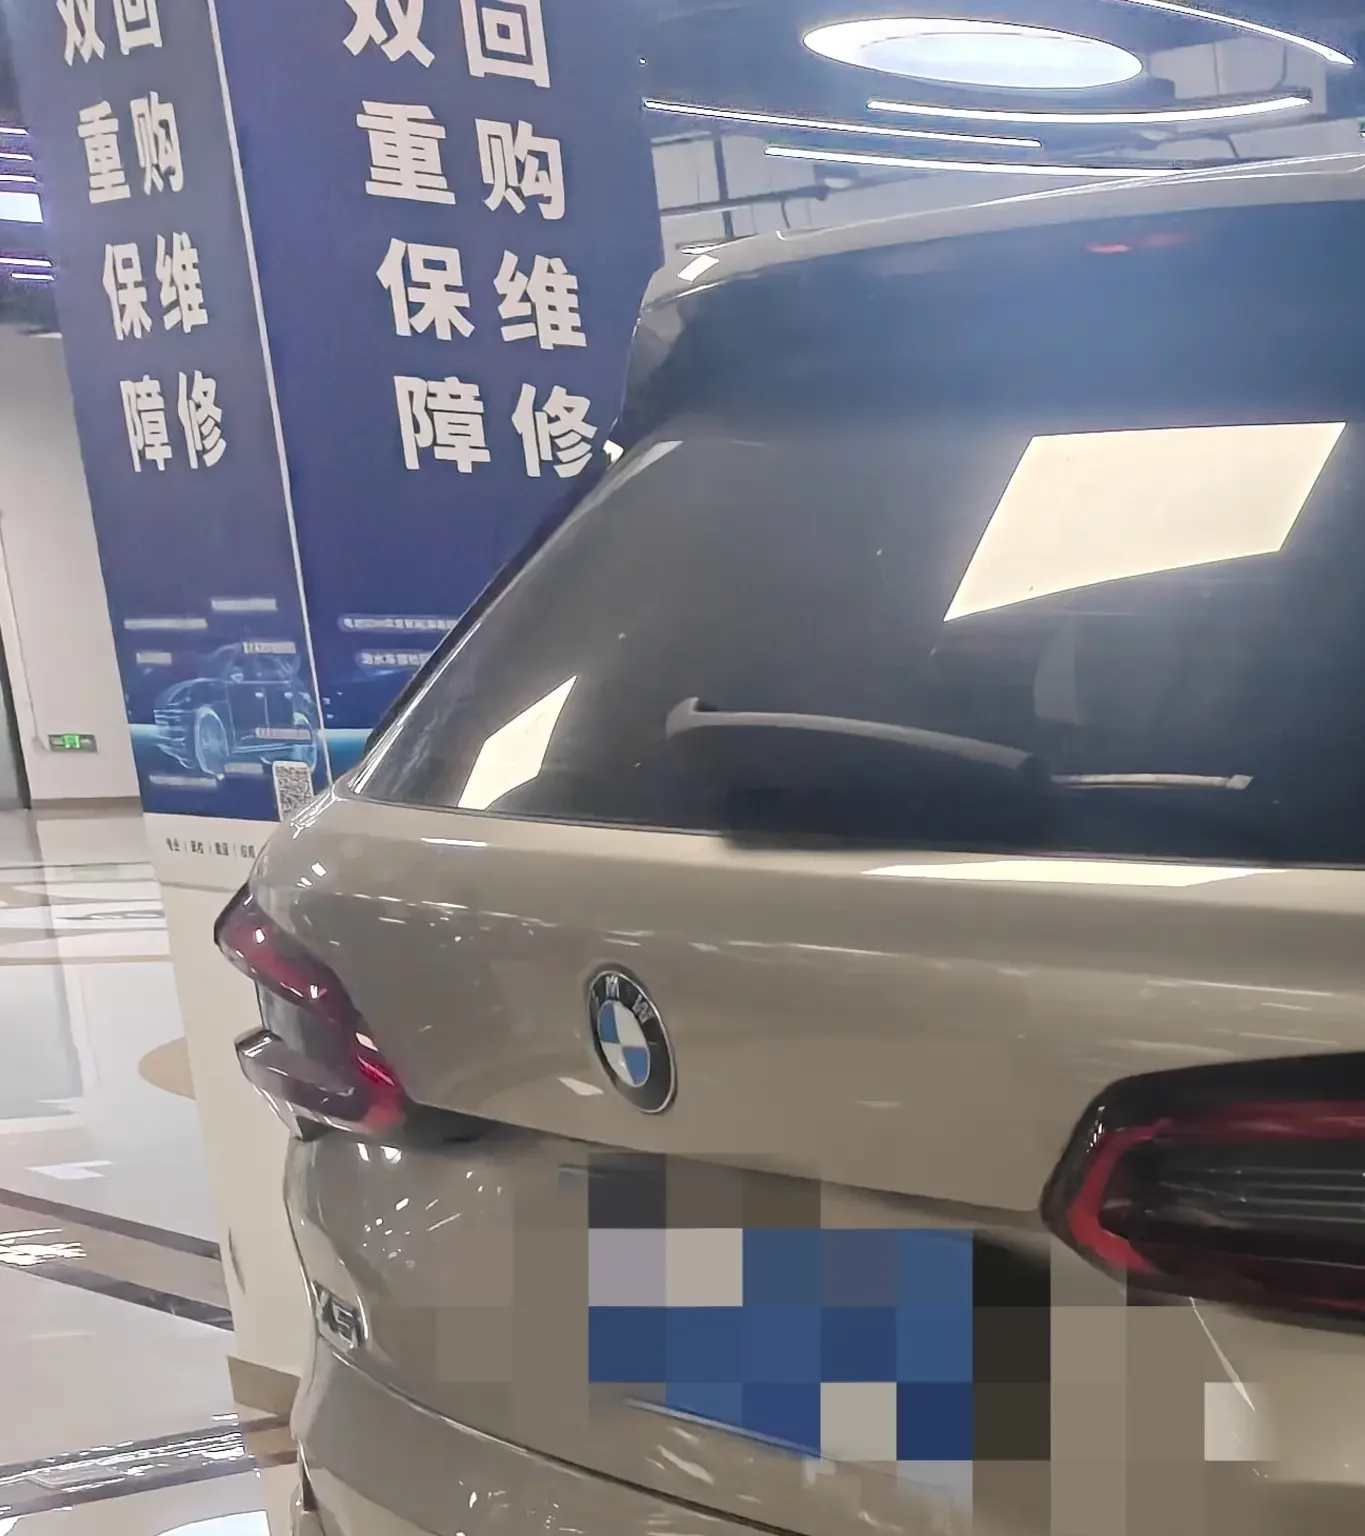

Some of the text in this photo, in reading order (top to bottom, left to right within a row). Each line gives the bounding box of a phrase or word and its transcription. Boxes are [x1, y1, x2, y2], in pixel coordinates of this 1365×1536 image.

[55, 0, 173, 472] 双重保障
[343, 0, 491, 474] 双重保障
[460, 0, 598, 479] 回购维修
